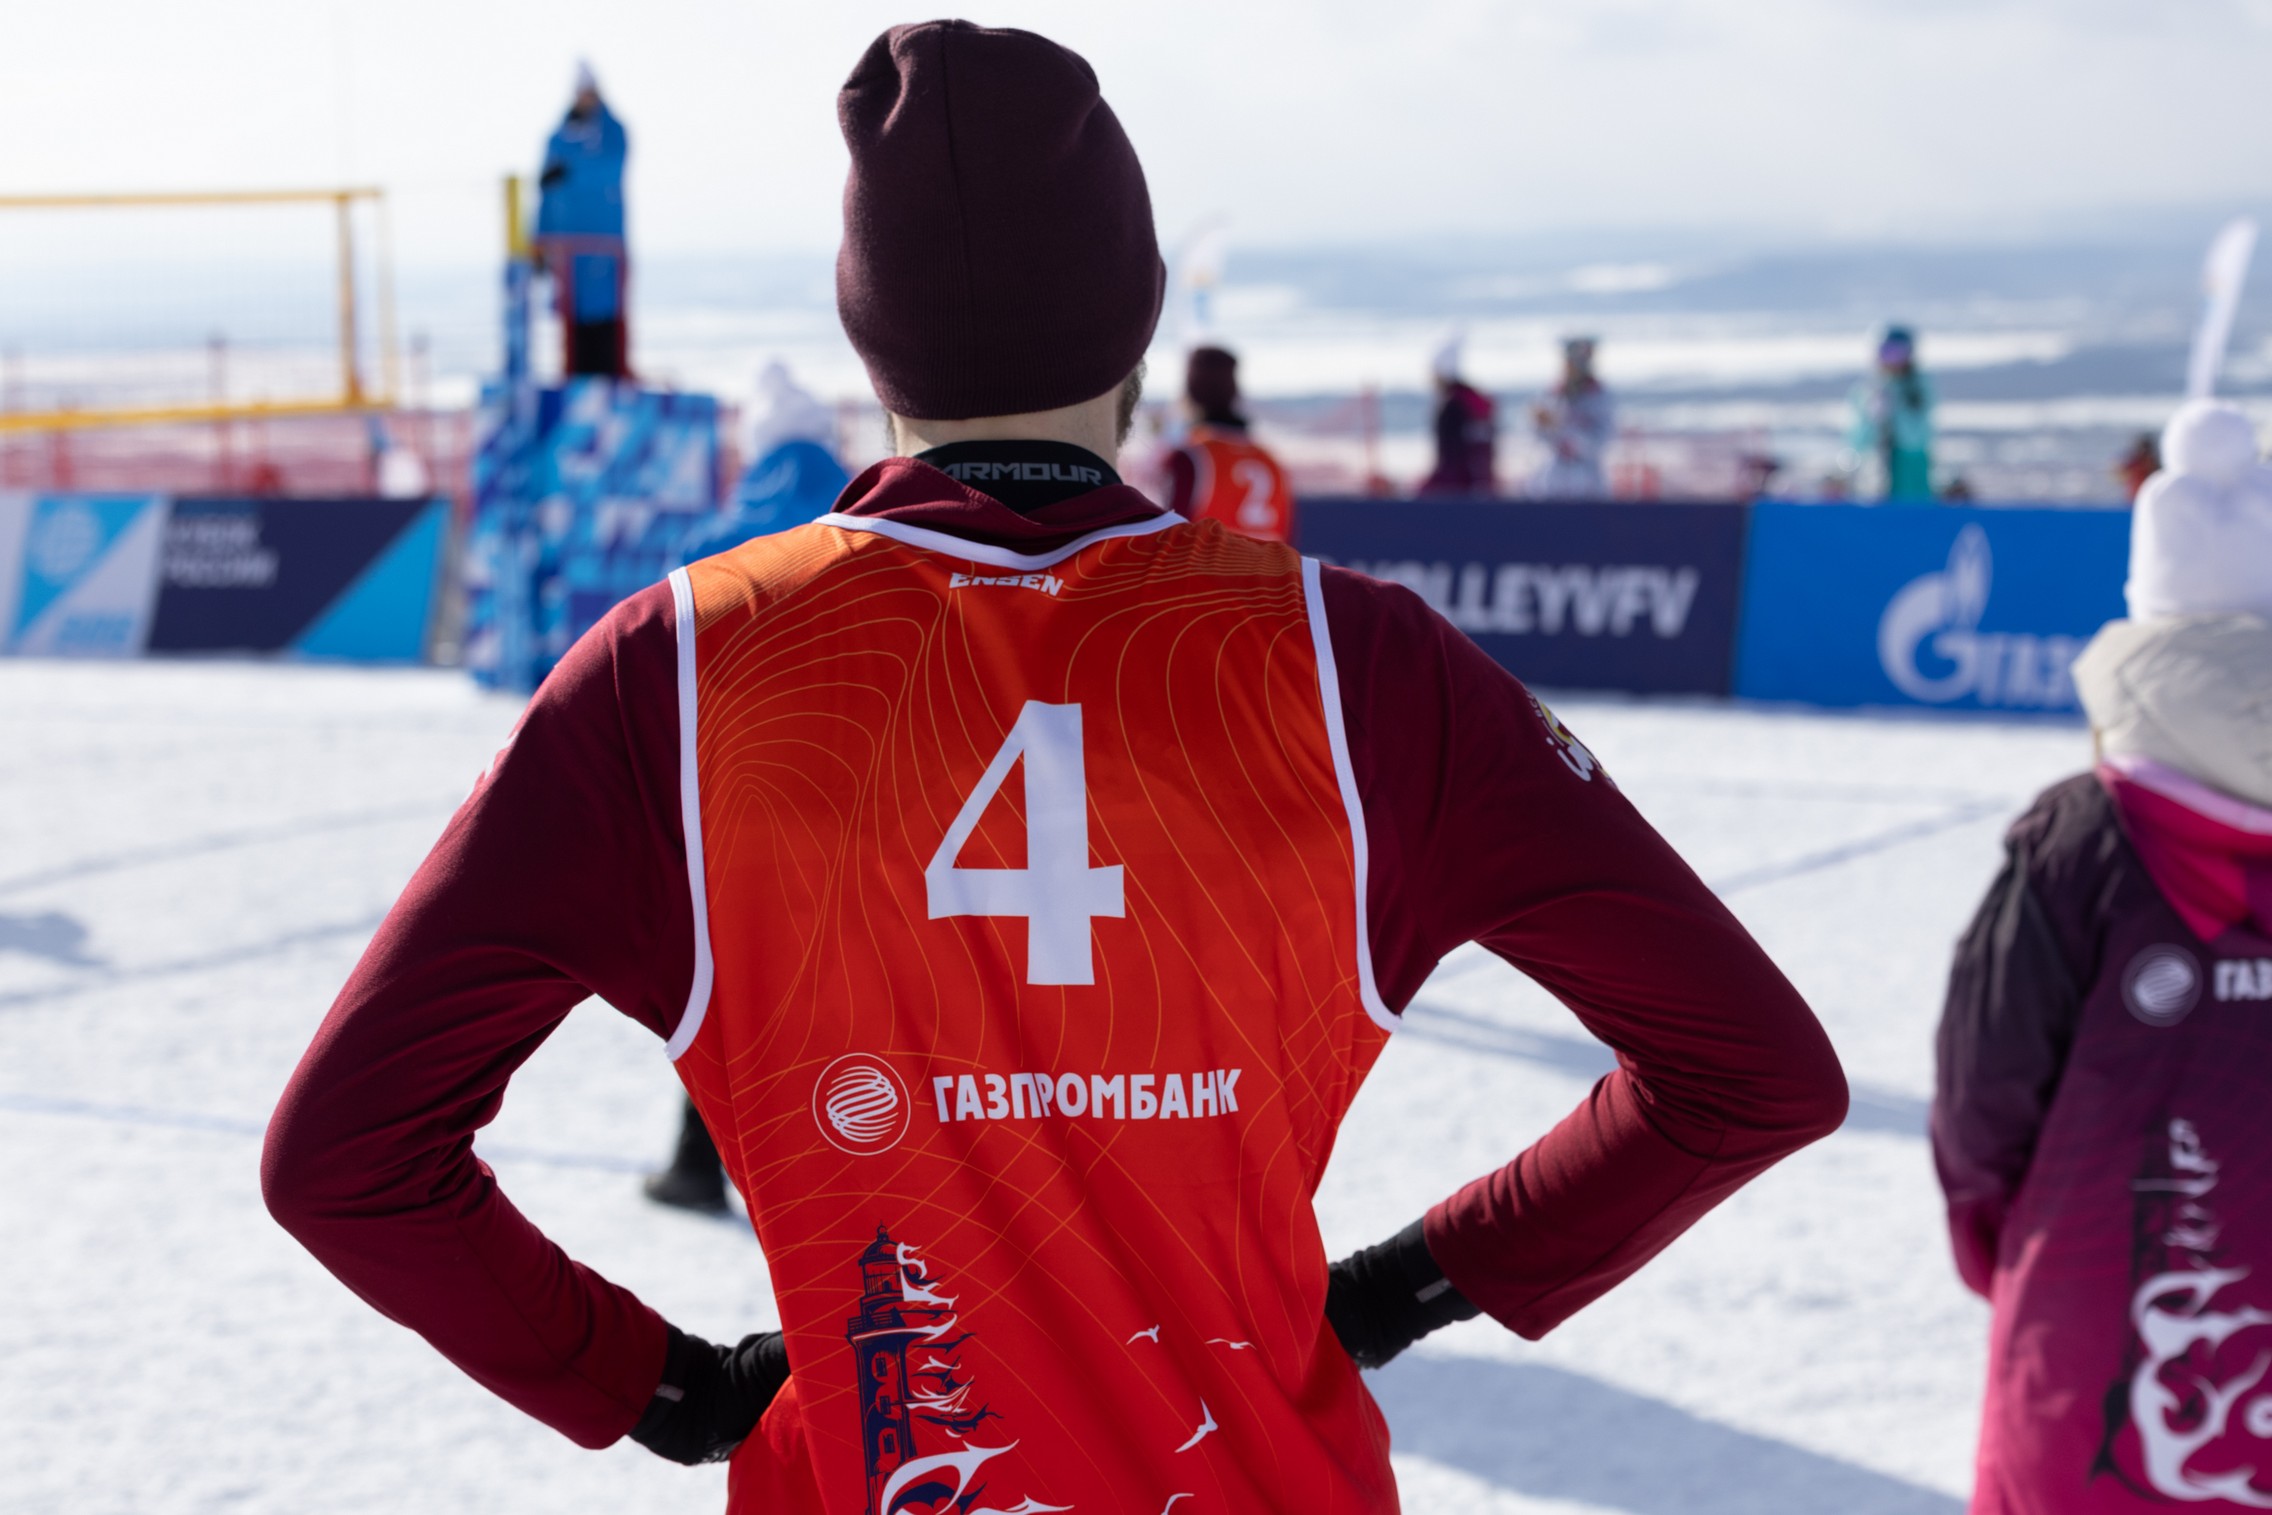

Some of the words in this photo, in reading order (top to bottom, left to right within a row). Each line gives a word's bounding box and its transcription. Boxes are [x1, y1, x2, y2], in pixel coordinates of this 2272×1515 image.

[944, 462, 1102, 486] ARMOUR
[1231, 459, 1279, 529] 2
[924, 699, 1126, 986] 4
[932, 1068, 1242, 1123] ГАЗПРОМБАНК
